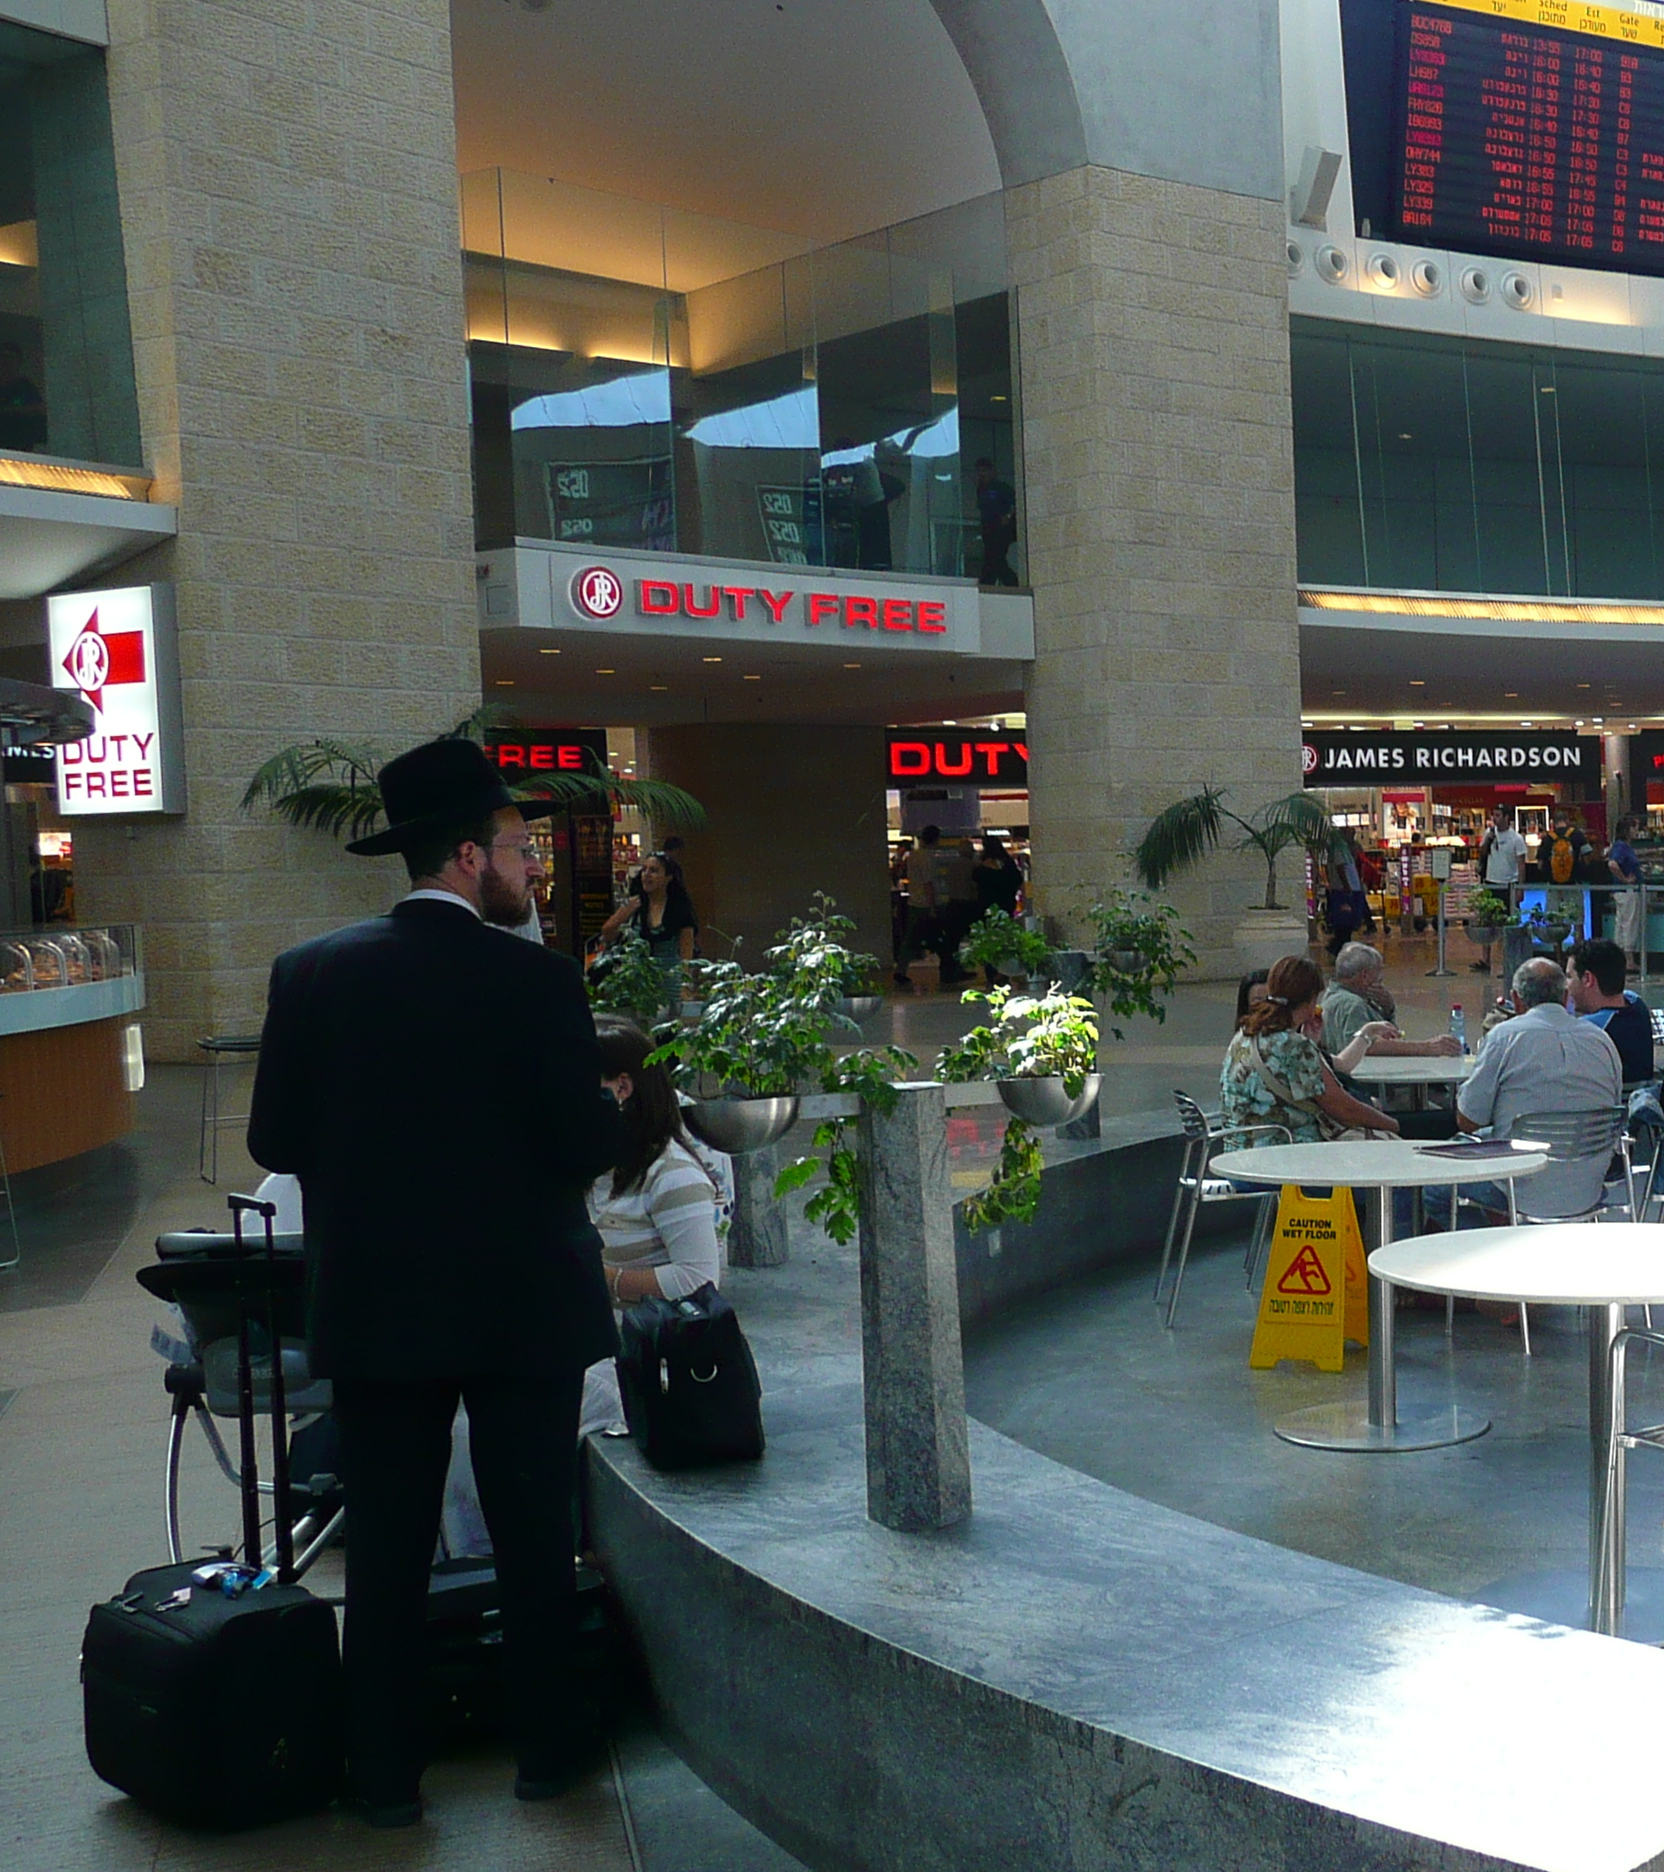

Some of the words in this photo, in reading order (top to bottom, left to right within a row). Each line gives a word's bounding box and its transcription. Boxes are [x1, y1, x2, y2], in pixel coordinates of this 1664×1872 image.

[1586, 7, 1600, 18] Est
[1619, 14, 1639, 26] Gate
[637, 578, 794, 624] DUTY
[809, 592, 947, 634] FREE
[62, 732, 155, 766] DUTY
[1325, 748, 1406, 769] JAMES
[1416, 746, 1582, 768] RICHARDSON
[65, 768, 154, 800] FREE
[1282, 1229, 1303, 1239] WET
[1305, 1230, 1337, 1240] FLOOR
[1289, 1218, 1332, 1229] CAUTION
